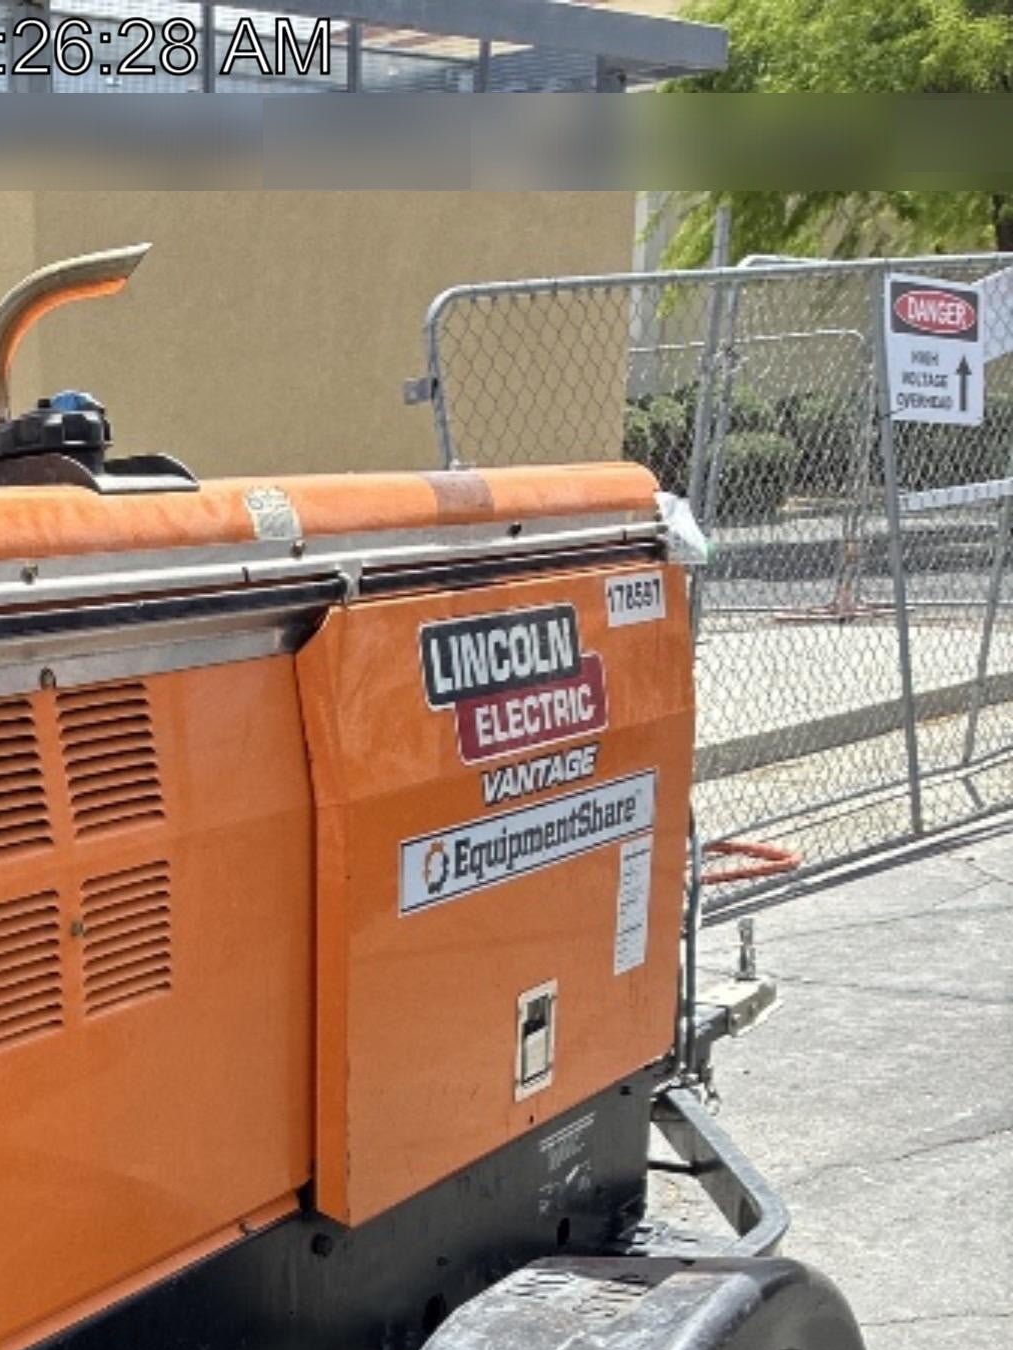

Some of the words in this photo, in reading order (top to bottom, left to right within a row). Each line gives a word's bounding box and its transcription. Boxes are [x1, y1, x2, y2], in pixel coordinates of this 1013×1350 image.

[907, 296, 967, 328] DANGER
[896, 393, 953, 411] OVERHEAD
[902, 371, 948, 389] VOLTAGE
[430, 617, 574, 694] LINCOLN
[475, 684, 597, 748] ELECTRIC
[481, 742, 600, 805] VANTAGE
[453, 796, 637, 883] EquipmentShare
